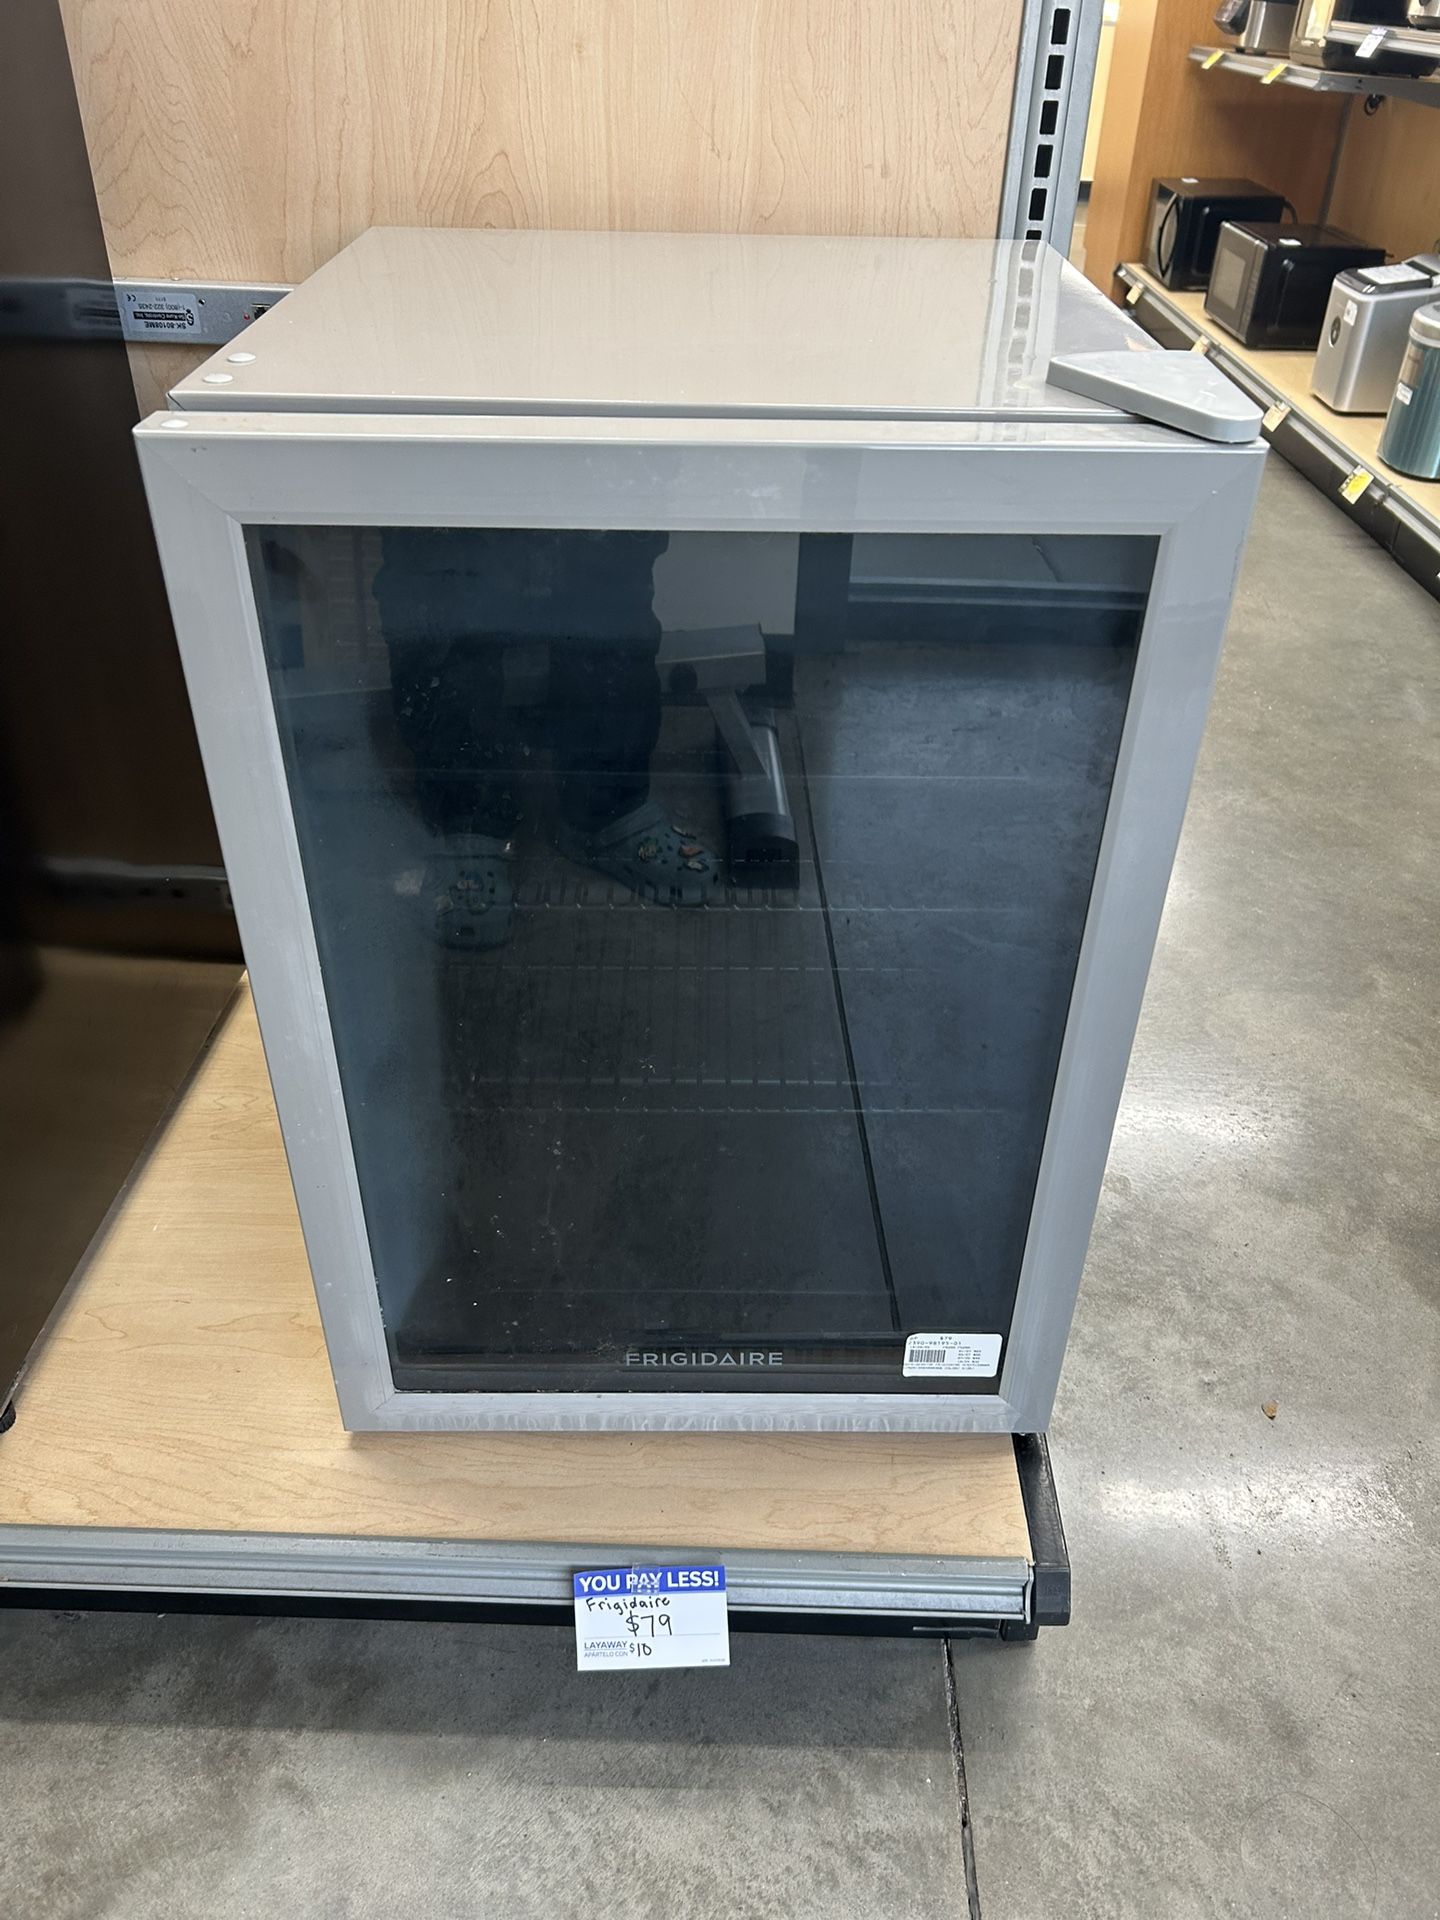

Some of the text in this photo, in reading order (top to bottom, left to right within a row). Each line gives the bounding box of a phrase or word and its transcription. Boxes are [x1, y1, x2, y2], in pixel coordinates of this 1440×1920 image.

[625, 1352, 783, 1366] FRIGIDAIRE
[579, 1570, 720, 1593] YOU PAY LESS!
[585, 1596, 671, 1615] Frigidaire
[626, 1610, 673, 1637] $79
[584, 1641, 652, 1657] LAYAWAY $10
